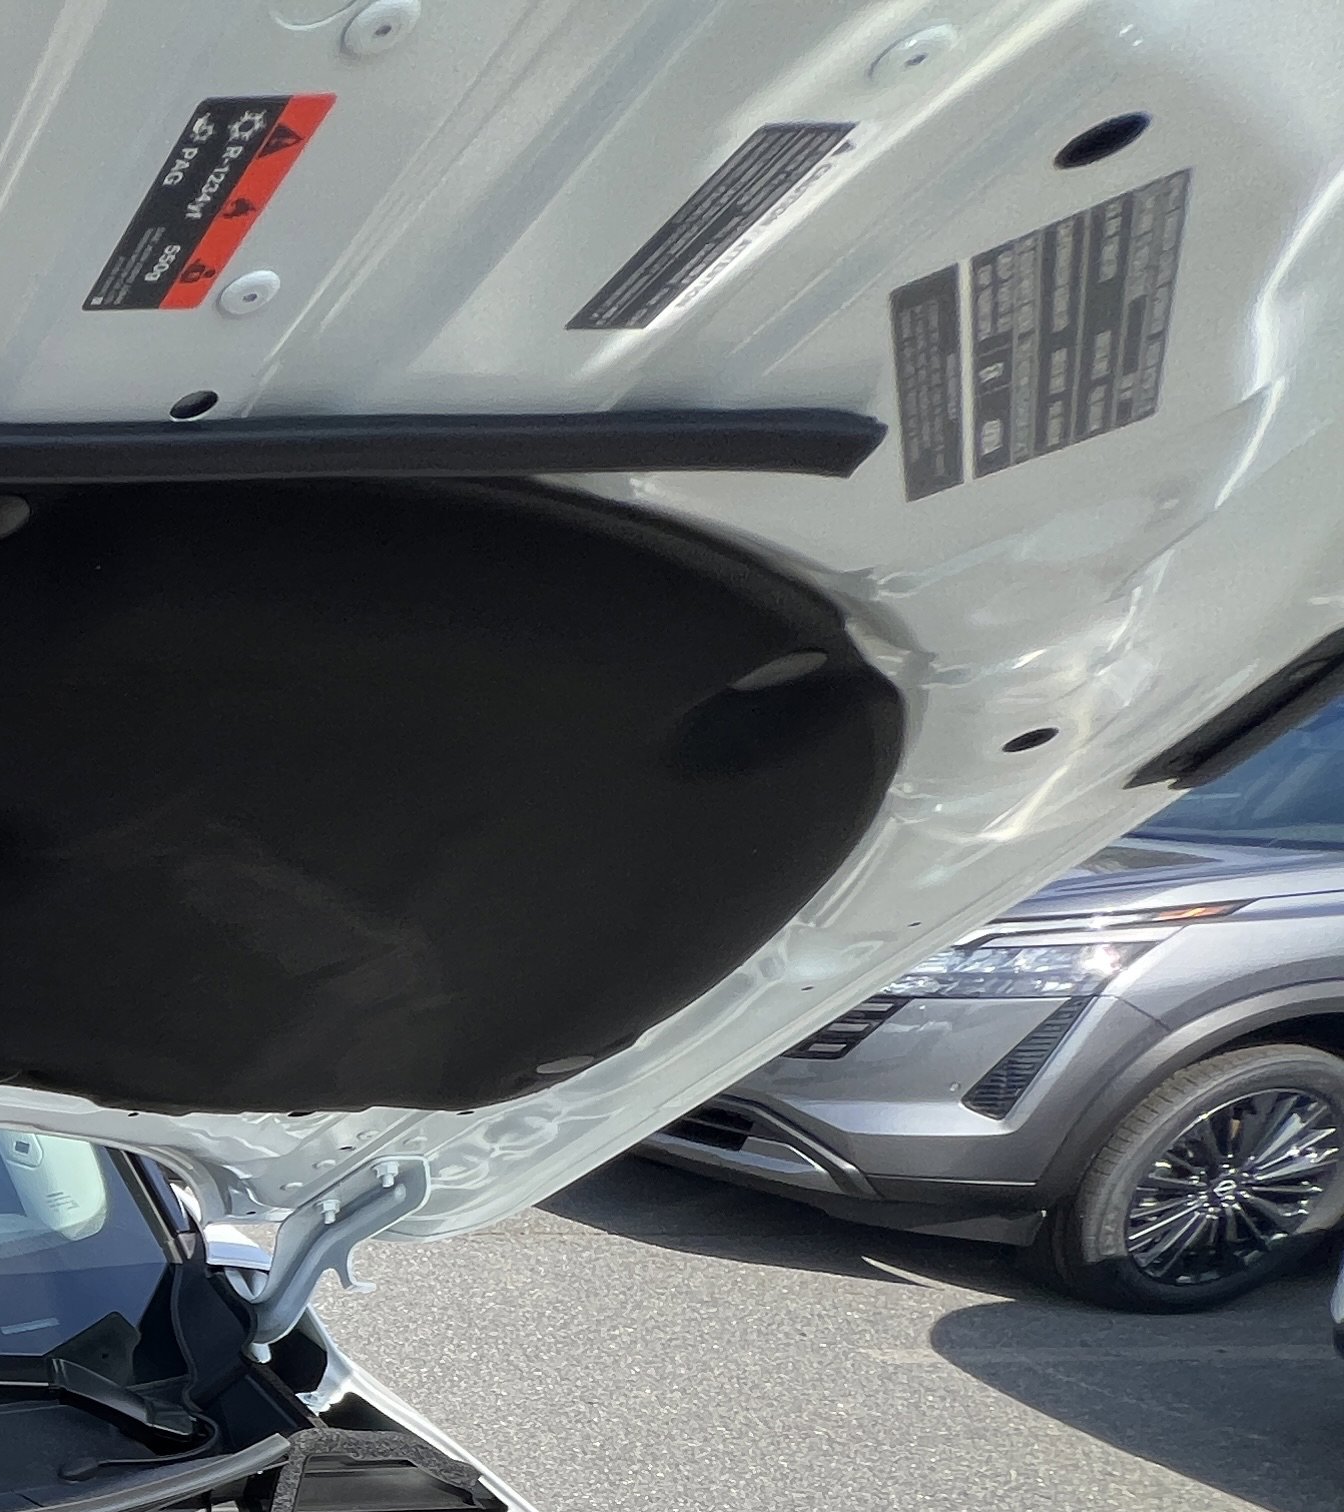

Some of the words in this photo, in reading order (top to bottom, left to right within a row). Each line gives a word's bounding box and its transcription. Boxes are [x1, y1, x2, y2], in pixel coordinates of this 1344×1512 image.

[162, 147, 198, 186] PAG
[184, 145, 243, 220] R-1234yf
[144, 244, 181, 282] 550g
